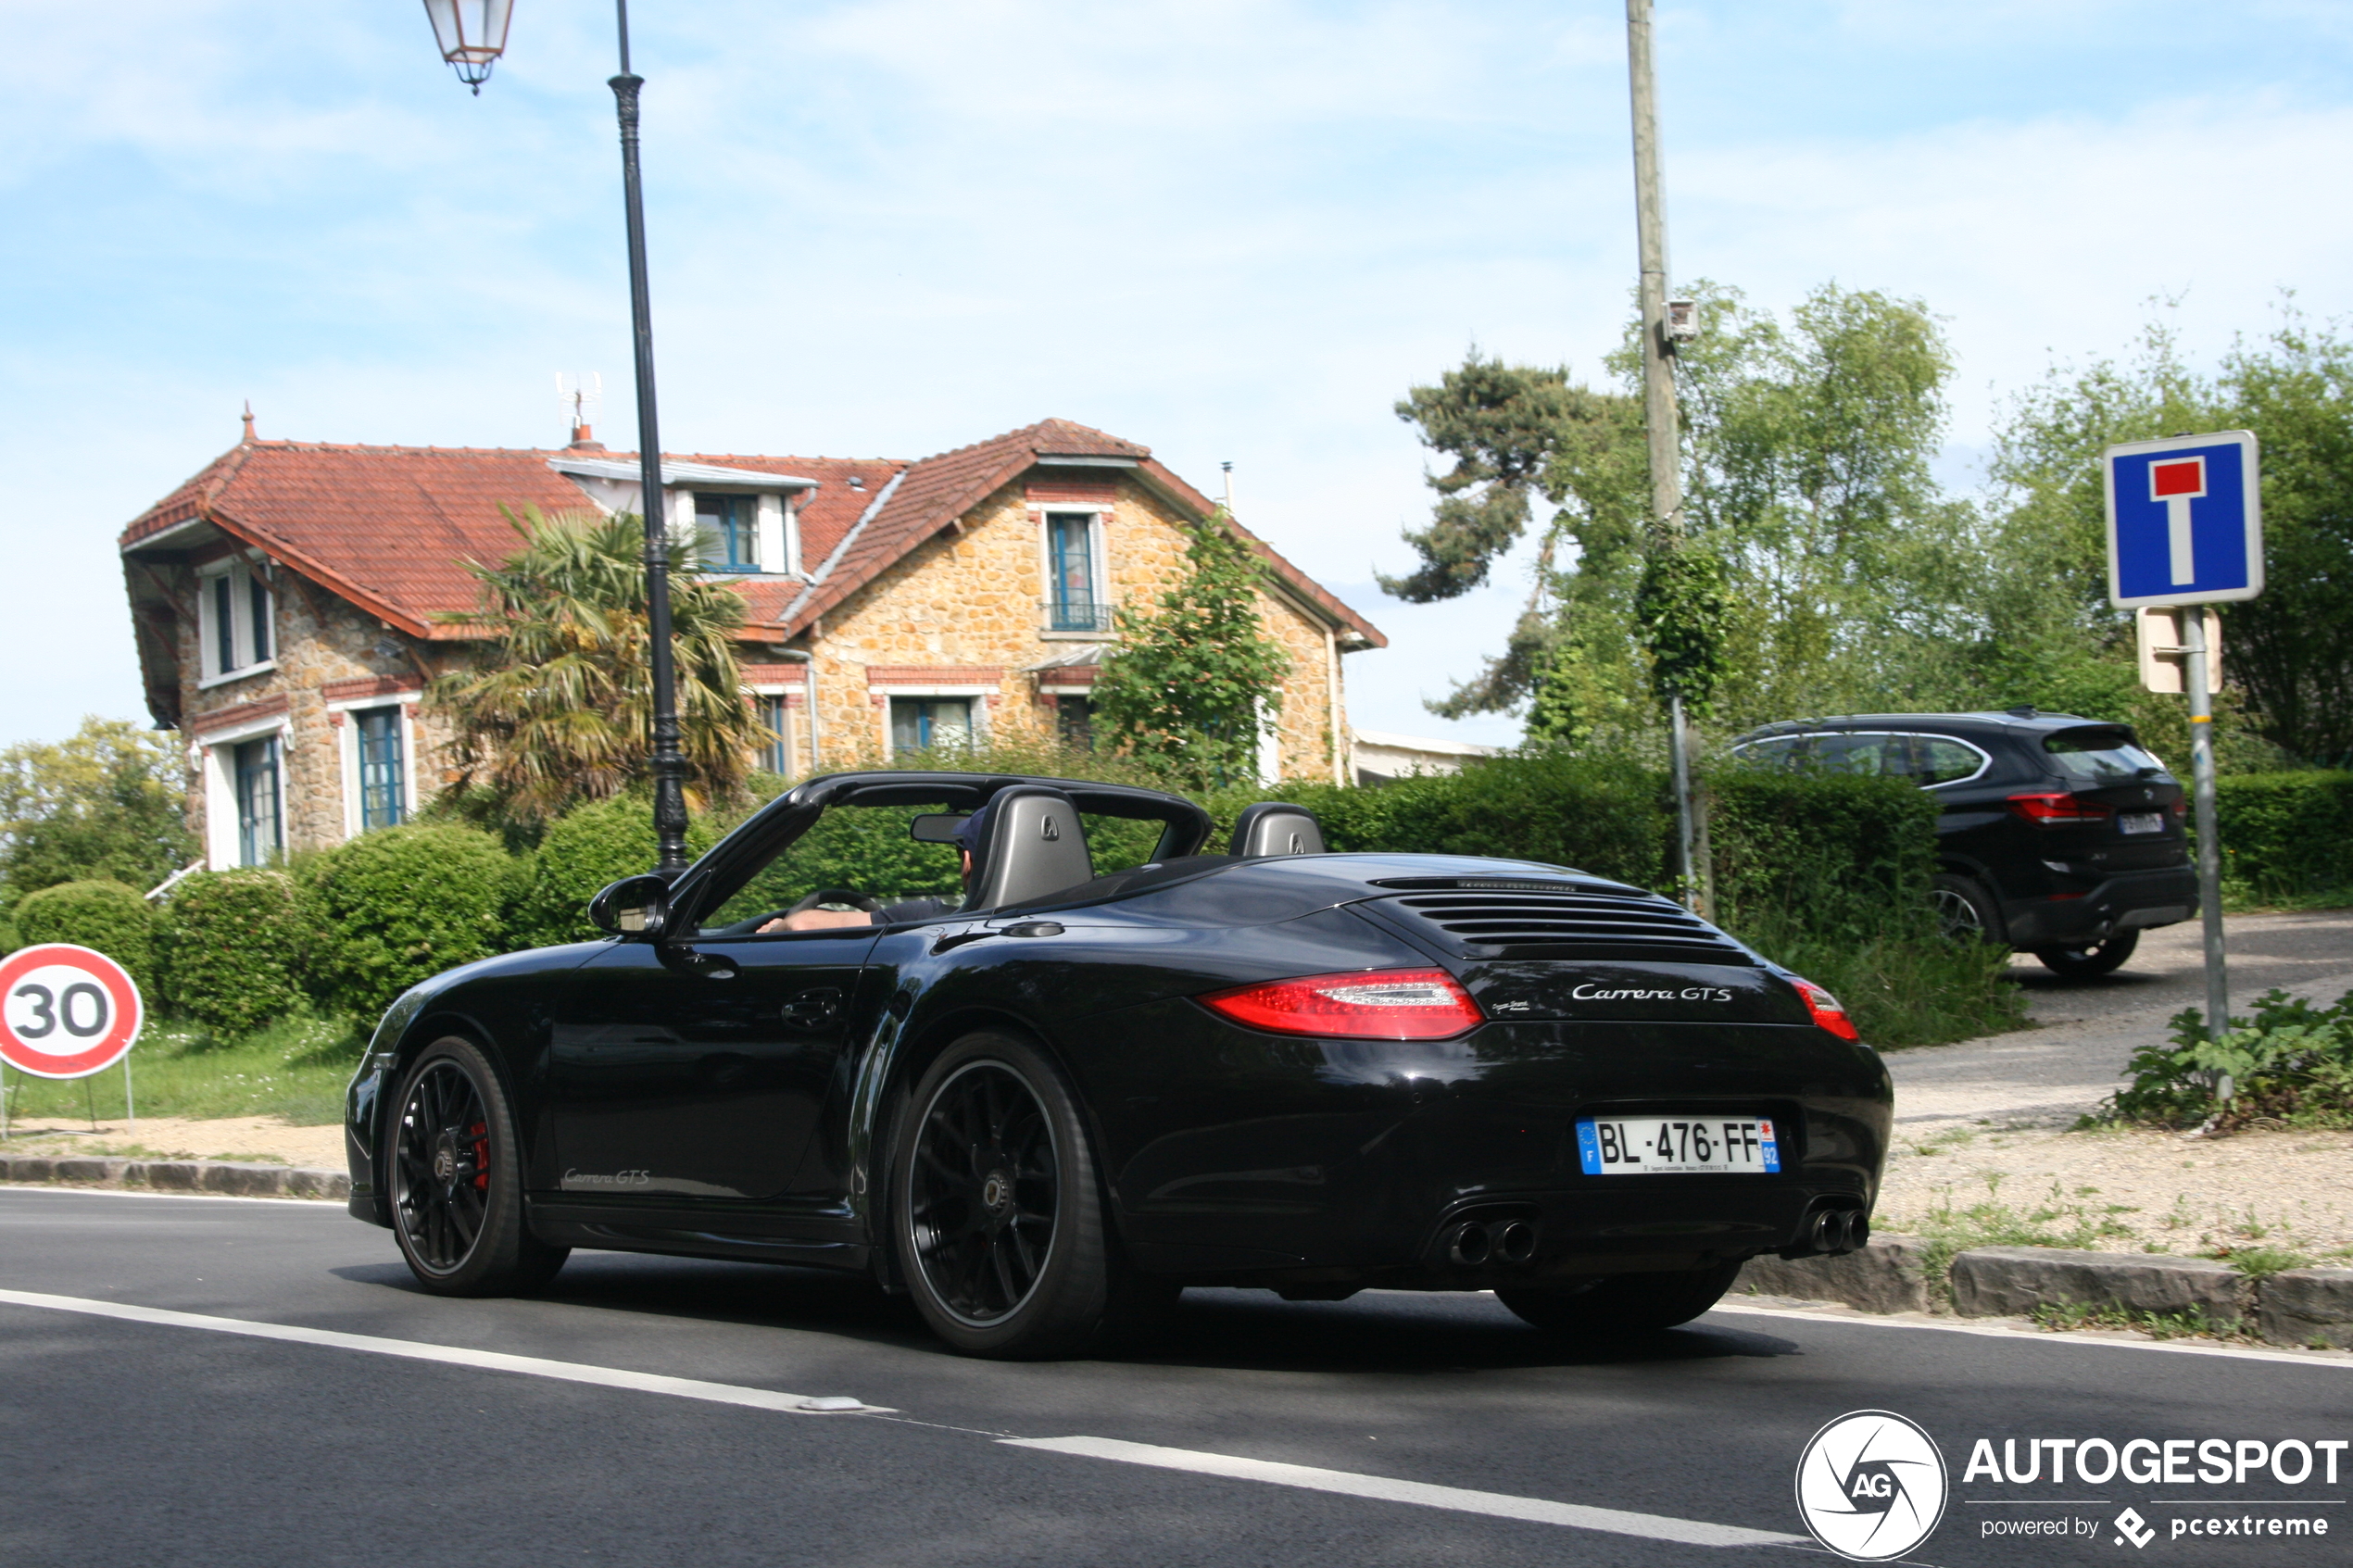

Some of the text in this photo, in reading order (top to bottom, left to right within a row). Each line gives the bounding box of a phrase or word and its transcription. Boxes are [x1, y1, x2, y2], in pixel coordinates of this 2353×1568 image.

[1572, 983, 1732, 1001] Carrera GTS
[13, 982, 108, 1038] 30
[1586, 1150, 1593, 1161] F
[1764, 1147, 1778, 1164] 92
[564, 1168, 649, 1185] Carrera GTS
